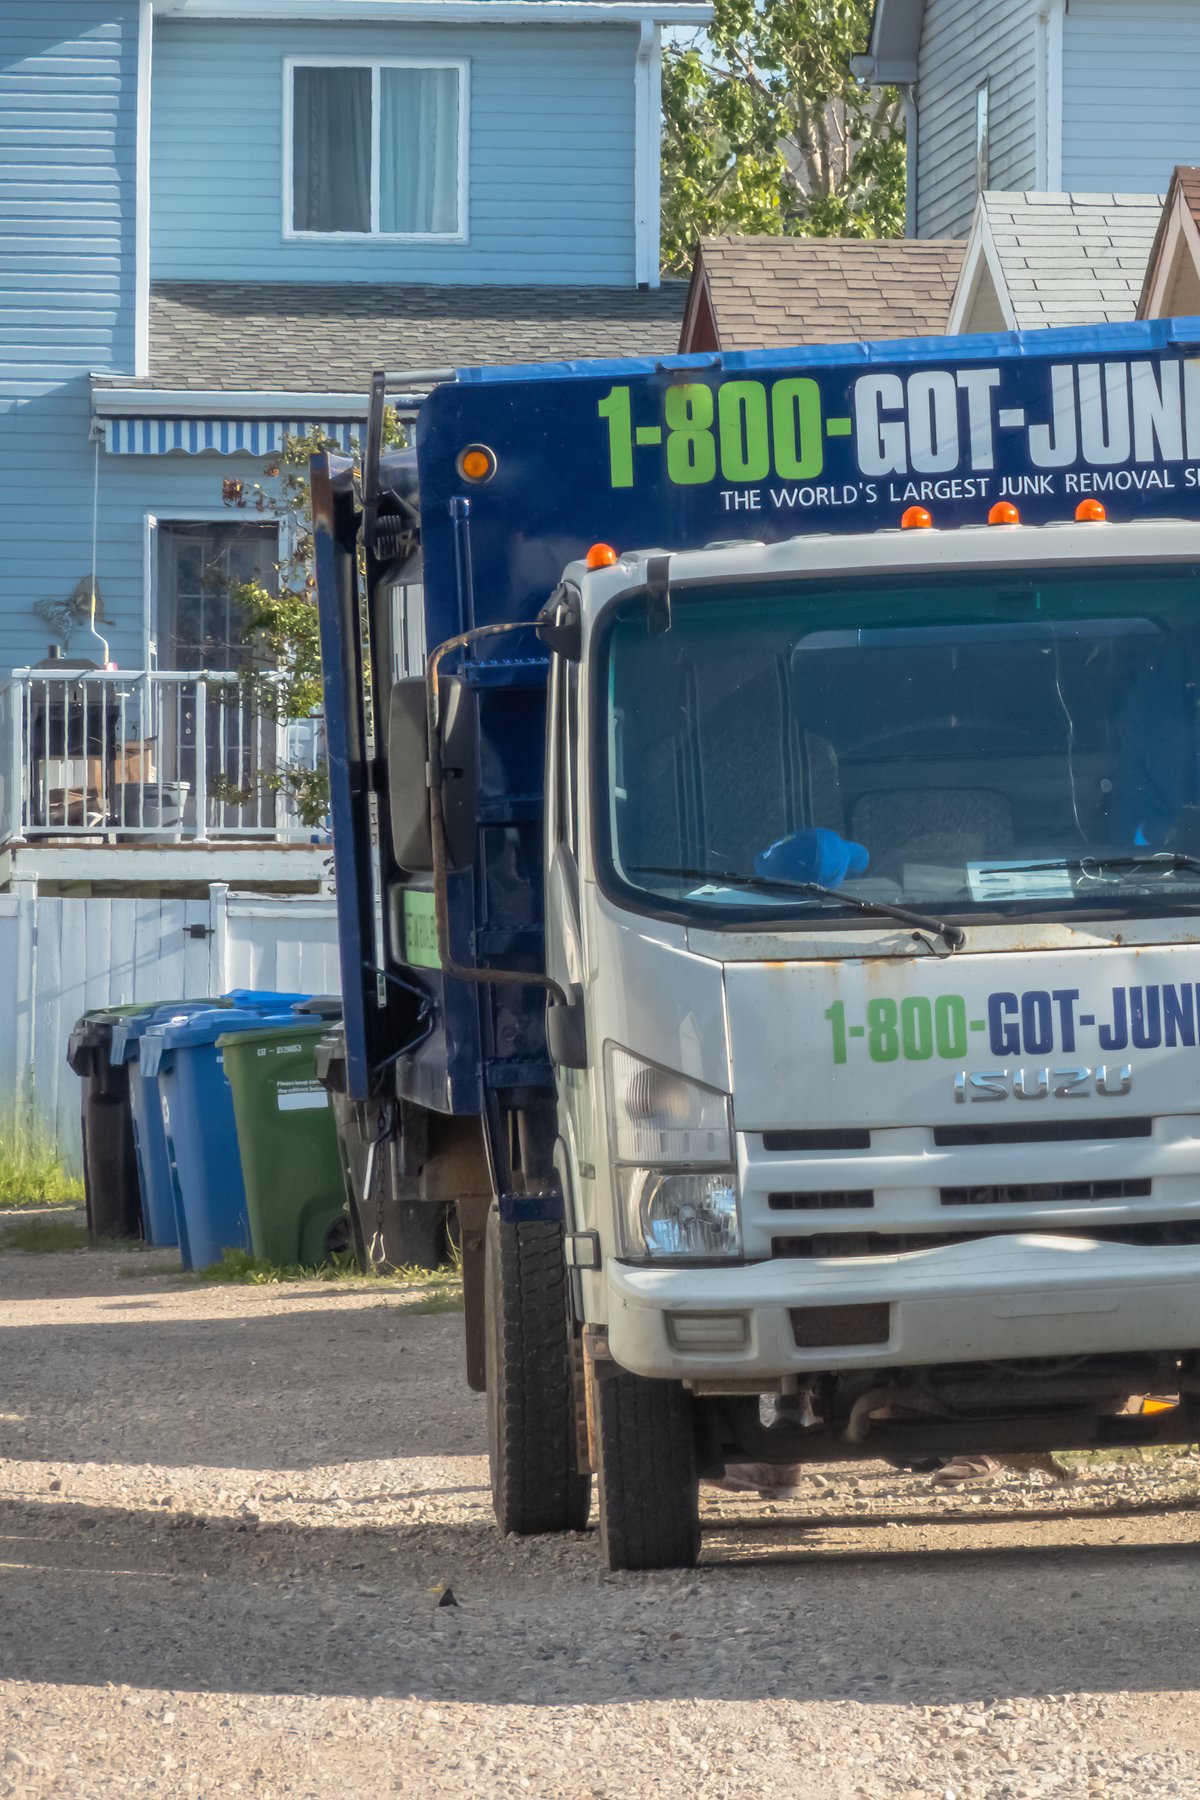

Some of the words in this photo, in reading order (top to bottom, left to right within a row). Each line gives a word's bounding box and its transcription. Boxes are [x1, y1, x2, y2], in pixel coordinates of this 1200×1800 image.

[720, 489, 761, 511] THE
[770, 482, 878, 508] WORLD'S
[890, 477, 990, 502] LARGEST
[998, 474, 1054, 496] JUNK
[1065, 469, 1175, 493] REMOVAL
[953, 1064, 1133, 1103] ISUZU
